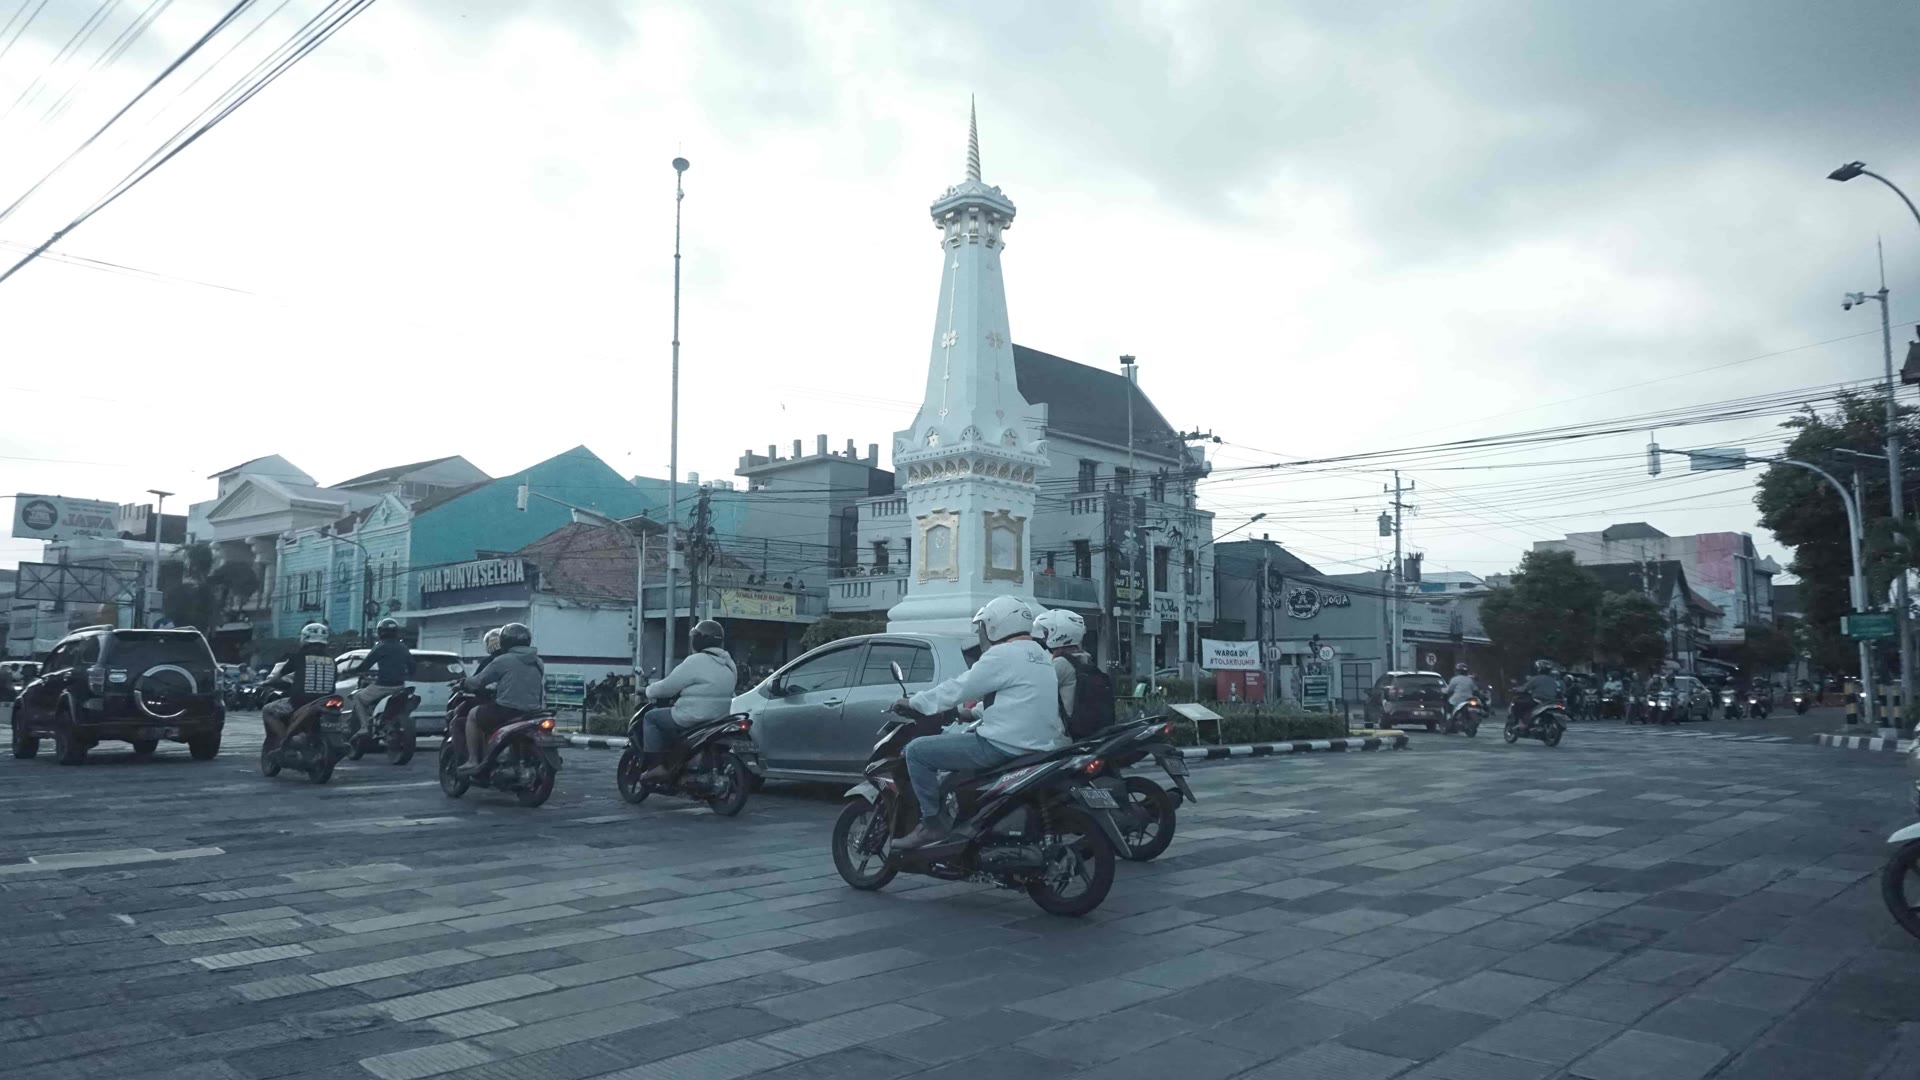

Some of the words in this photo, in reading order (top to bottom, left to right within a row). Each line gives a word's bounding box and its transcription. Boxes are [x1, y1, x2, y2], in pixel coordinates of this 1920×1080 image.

[62, 513, 115, 530] JAWA
[418, 569, 442, 593] PRIA
[443, 564, 479, 591] PUNYA
[480, 559, 525, 586] SELERA
[1323, 595, 1349, 606] JOGJA
[1215, 649, 1238, 657] WARGA
